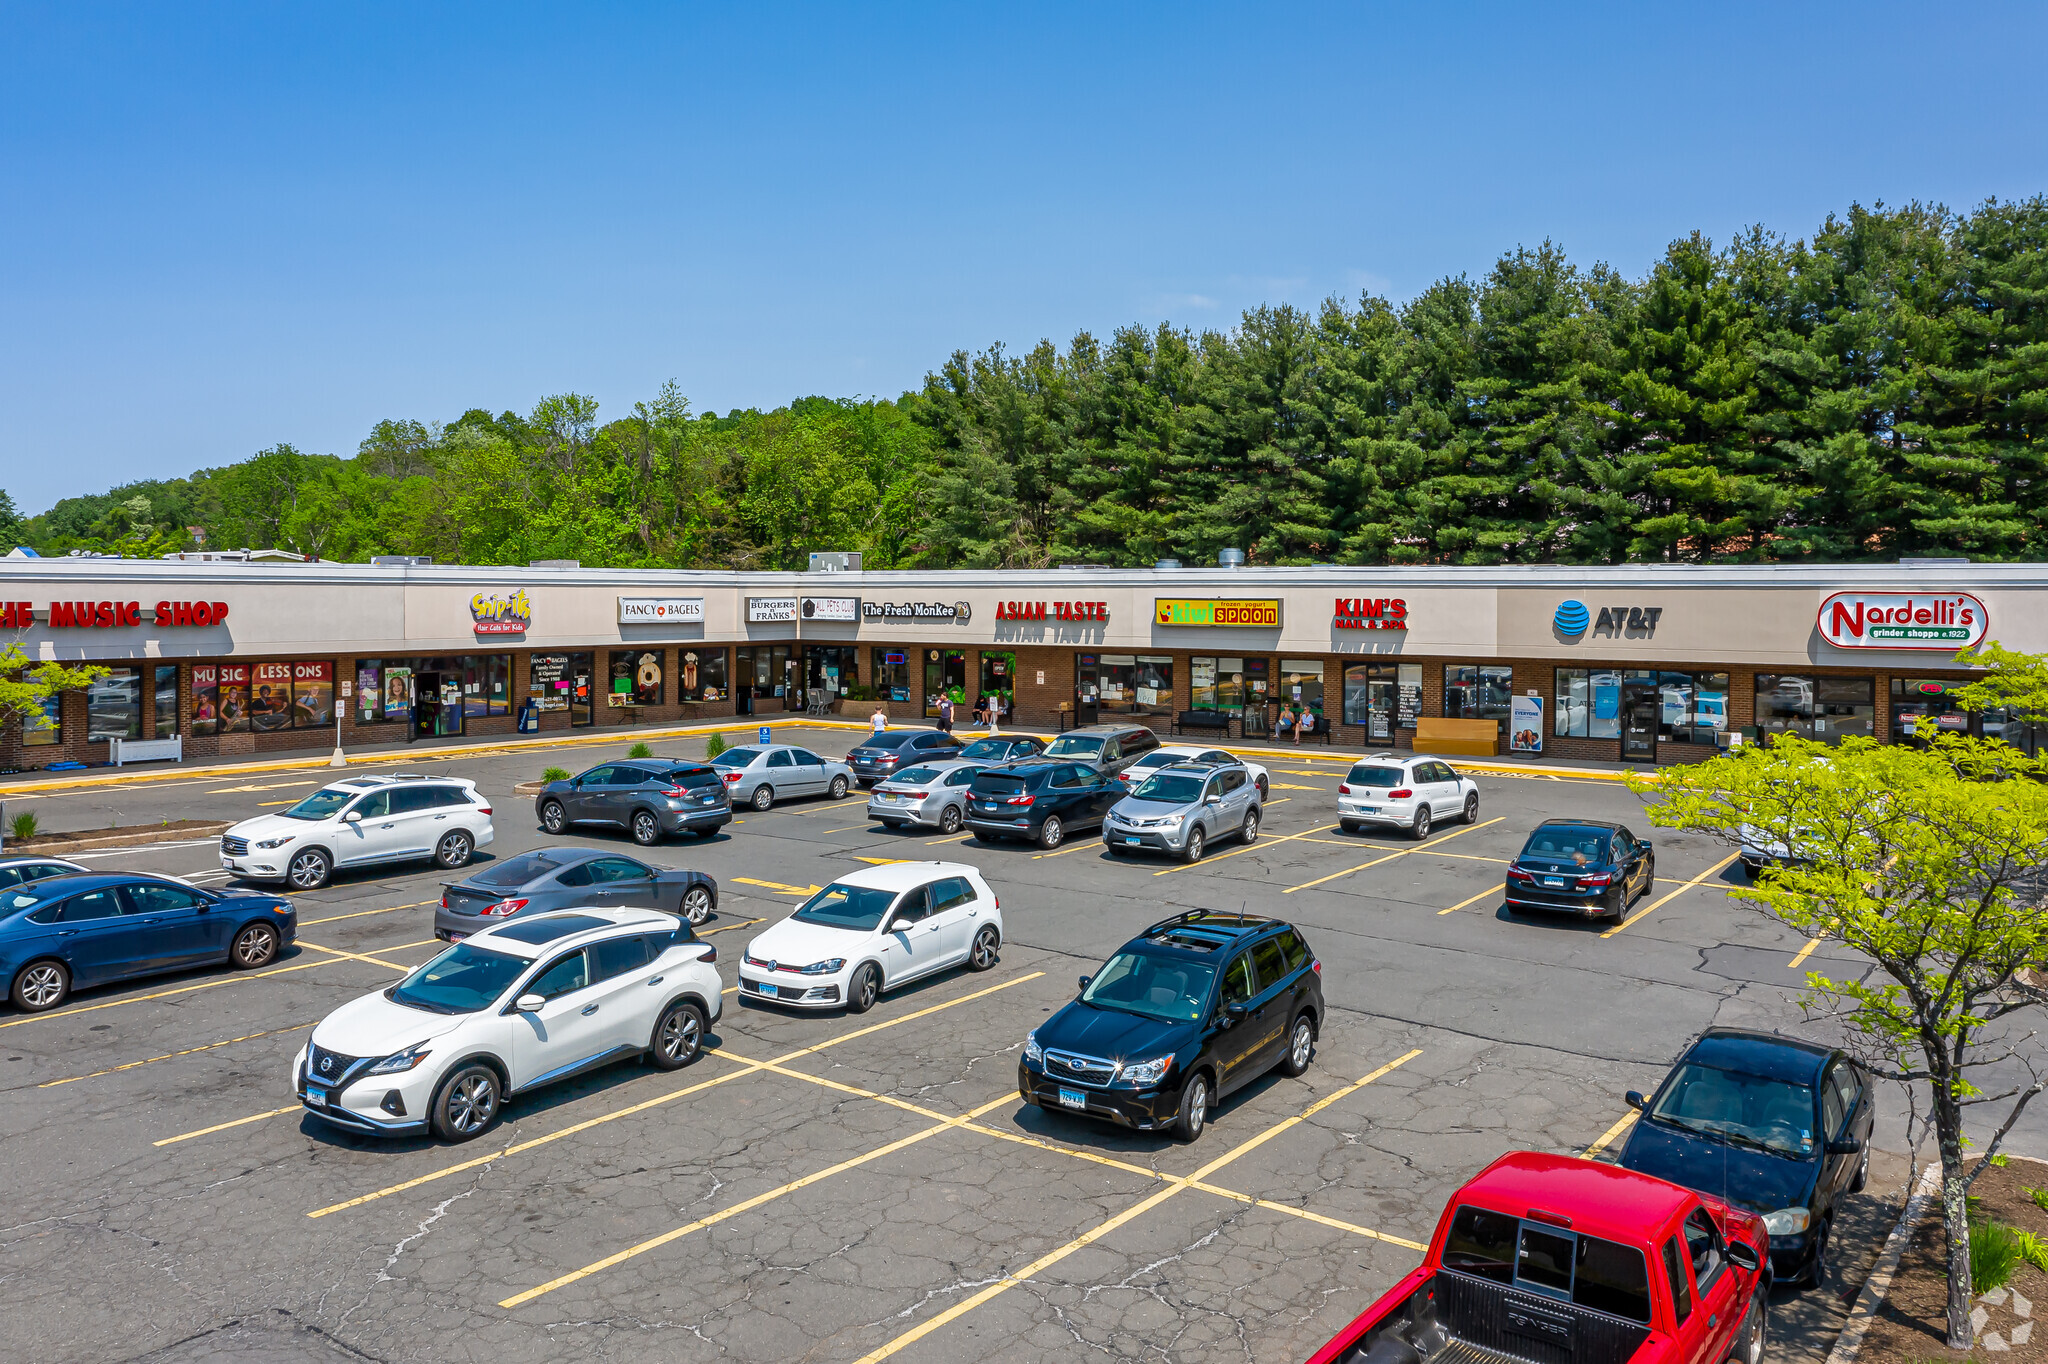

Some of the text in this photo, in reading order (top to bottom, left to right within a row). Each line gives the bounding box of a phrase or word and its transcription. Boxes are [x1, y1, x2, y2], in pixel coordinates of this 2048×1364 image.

[472, 588, 530, 620] Snip-its
[625, 604, 700, 615] FANCY BAGELS
[863, 603, 955, 616] The Fresh MonKee
[996, 601, 1107, 622] ASIAN TASTE
[1173, 603, 1276, 623] kiwi spoon
[1335, 598, 1407, 618] KIM'S
[49, 601, 141, 627] MUSIC
[154, 600, 229, 627] SHOP
[756, 611, 790, 620] FRANKS
[1594, 606, 1663, 630] AT&T
[1832, 598, 1974, 637] Nardelli's
[1335, 619, 1406, 630] NAIL & SPA
[1873, 629, 1904, 637] grinder
[1907, 631, 1939, 639] shoppe
[1949, 630, 1966, 638] 1922
[194, 665, 322, 682] MUSIC LESSONS
[1920, 683, 1942, 693] OPEN
